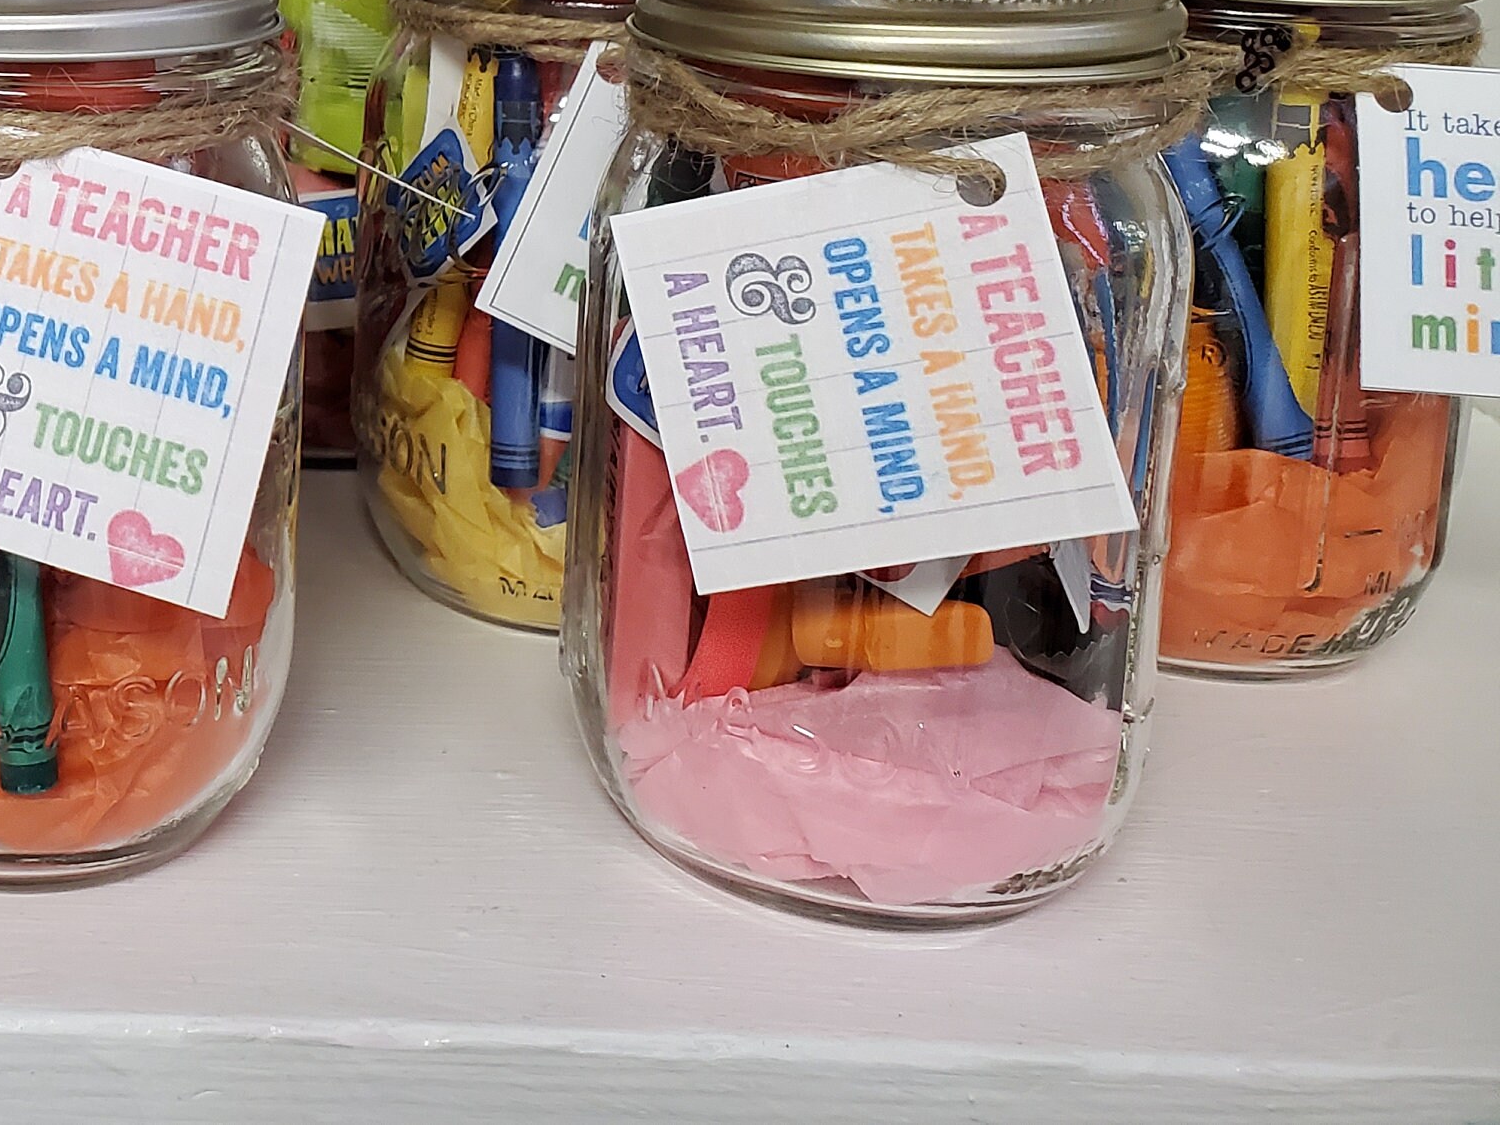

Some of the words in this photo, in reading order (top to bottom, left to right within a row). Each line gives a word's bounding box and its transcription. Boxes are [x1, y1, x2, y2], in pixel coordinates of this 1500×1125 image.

[1404, 109, 1429, 132] It
[1443, 111, 1500, 136] take
[5, 173, 32, 219] A
[48, 173, 262, 282] TEACHER
[957, 211, 1010, 241] A
[1407, 202, 1437, 225] to
[104, 271, 130, 313] A
[140, 281, 246, 353] HAND,
[662, 271, 711, 298] A
[724, 251, 817, 326] &
[822, 236, 891, 360] OPENS
[889, 221, 960, 338] TAKES
[94, 337, 122, 381] A
[129, 346, 234, 419] MIND,
[672, 304, 742, 445] HEART.
[853, 369, 899, 395] A
[920, 349, 967, 377] A
[970, 242, 1084, 478] TEACHER
[33, 401, 210, 497] TOUCHES
[754, 332, 839, 519] TOUCHES
[861, 400, 927, 516] MIND,
[928, 382, 996, 501] HAND,
